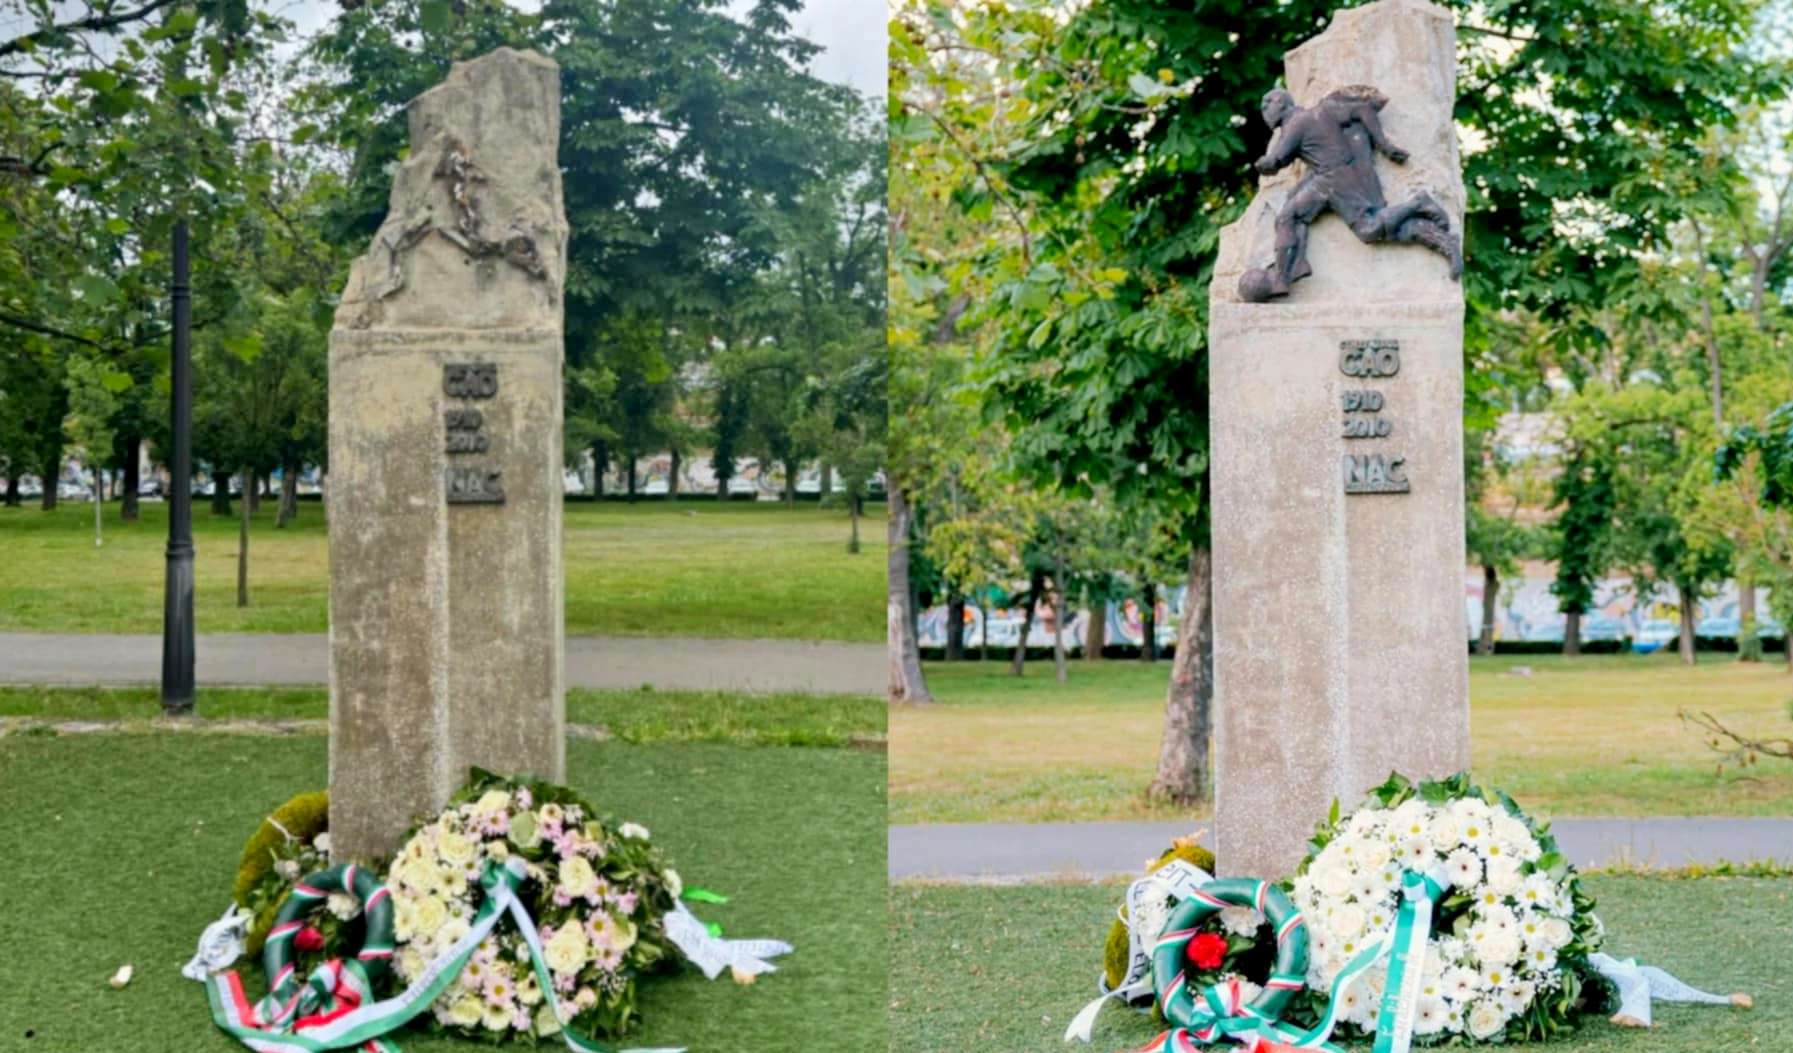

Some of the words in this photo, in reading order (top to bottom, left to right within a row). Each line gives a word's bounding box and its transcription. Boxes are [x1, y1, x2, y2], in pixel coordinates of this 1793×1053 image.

[1340, 347, 1400, 377] CAO
[1341, 390, 1384, 412] 1910
[1342, 418, 1391, 438] 2010
[1343, 454, 1409, 485] NAC
